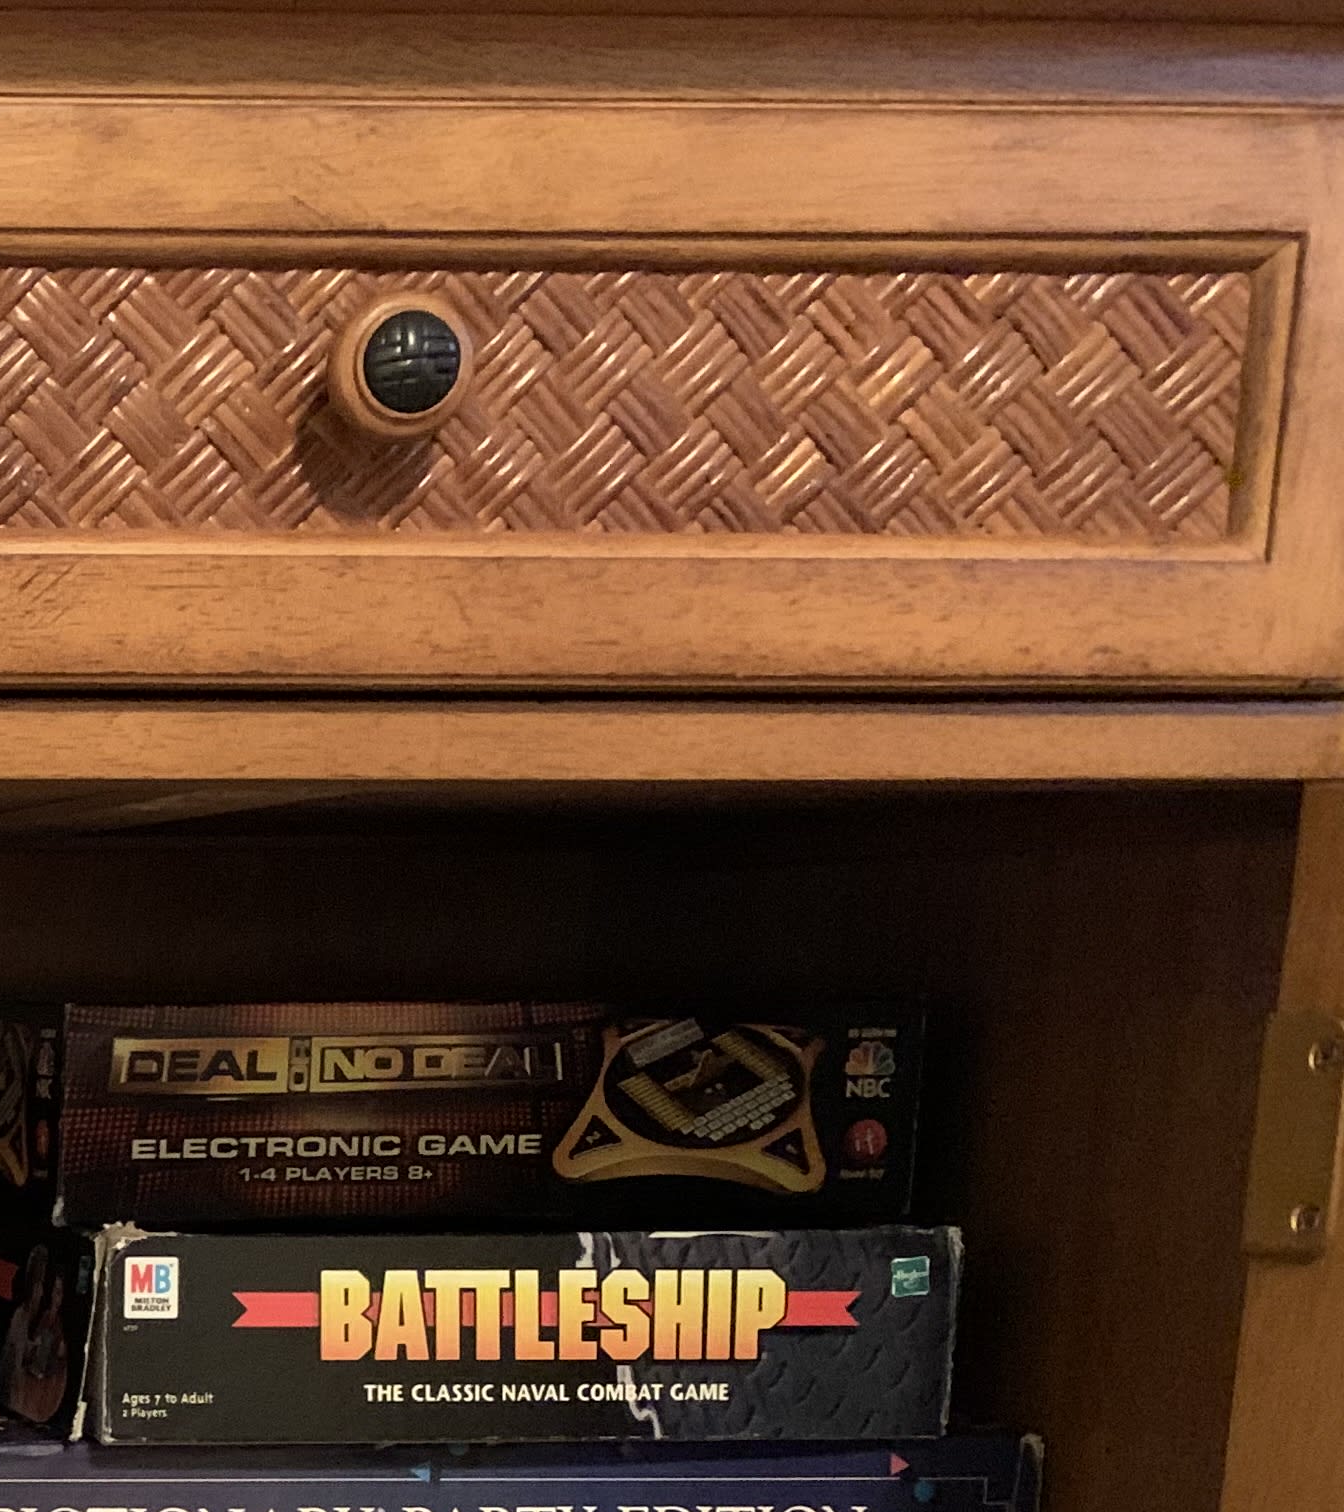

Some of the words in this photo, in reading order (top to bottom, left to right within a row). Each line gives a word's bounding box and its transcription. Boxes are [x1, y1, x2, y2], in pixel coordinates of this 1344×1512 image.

[120, 1049, 278, 1083] DEAL
[323, 1046, 404, 1081] NO
[845, 1077, 892, 1098] NBC
[131, 1135, 402, 1160] ELECTRONIC
[416, 1133, 543, 1157] GAME
[238, 1167, 277, 1182] 1-4
[284, 1165, 400, 1181] PLAYERS
[407, 1165, 434, 1181] 8+
[130, 1263, 172, 1294] MB
[131, 1304, 172, 1312] BRADLEY
[319, 1267, 787, 1362] BATTLESHIP
[122, 1392, 151, 1407] Ages
[154, 1394, 161, 1405] 7
[164, 1393, 178, 1404] to
[180, 1392, 214, 1405] Adult
[362, 1383, 404, 1403] THE
[410, 1383, 493, 1403] CLASSIC
[500, 1383, 570, 1403] NAVAL
[576, 1383, 663, 1402] COMBAT
[669, 1383, 731, 1402] GAME
[130, 1408, 168, 1420] Players
